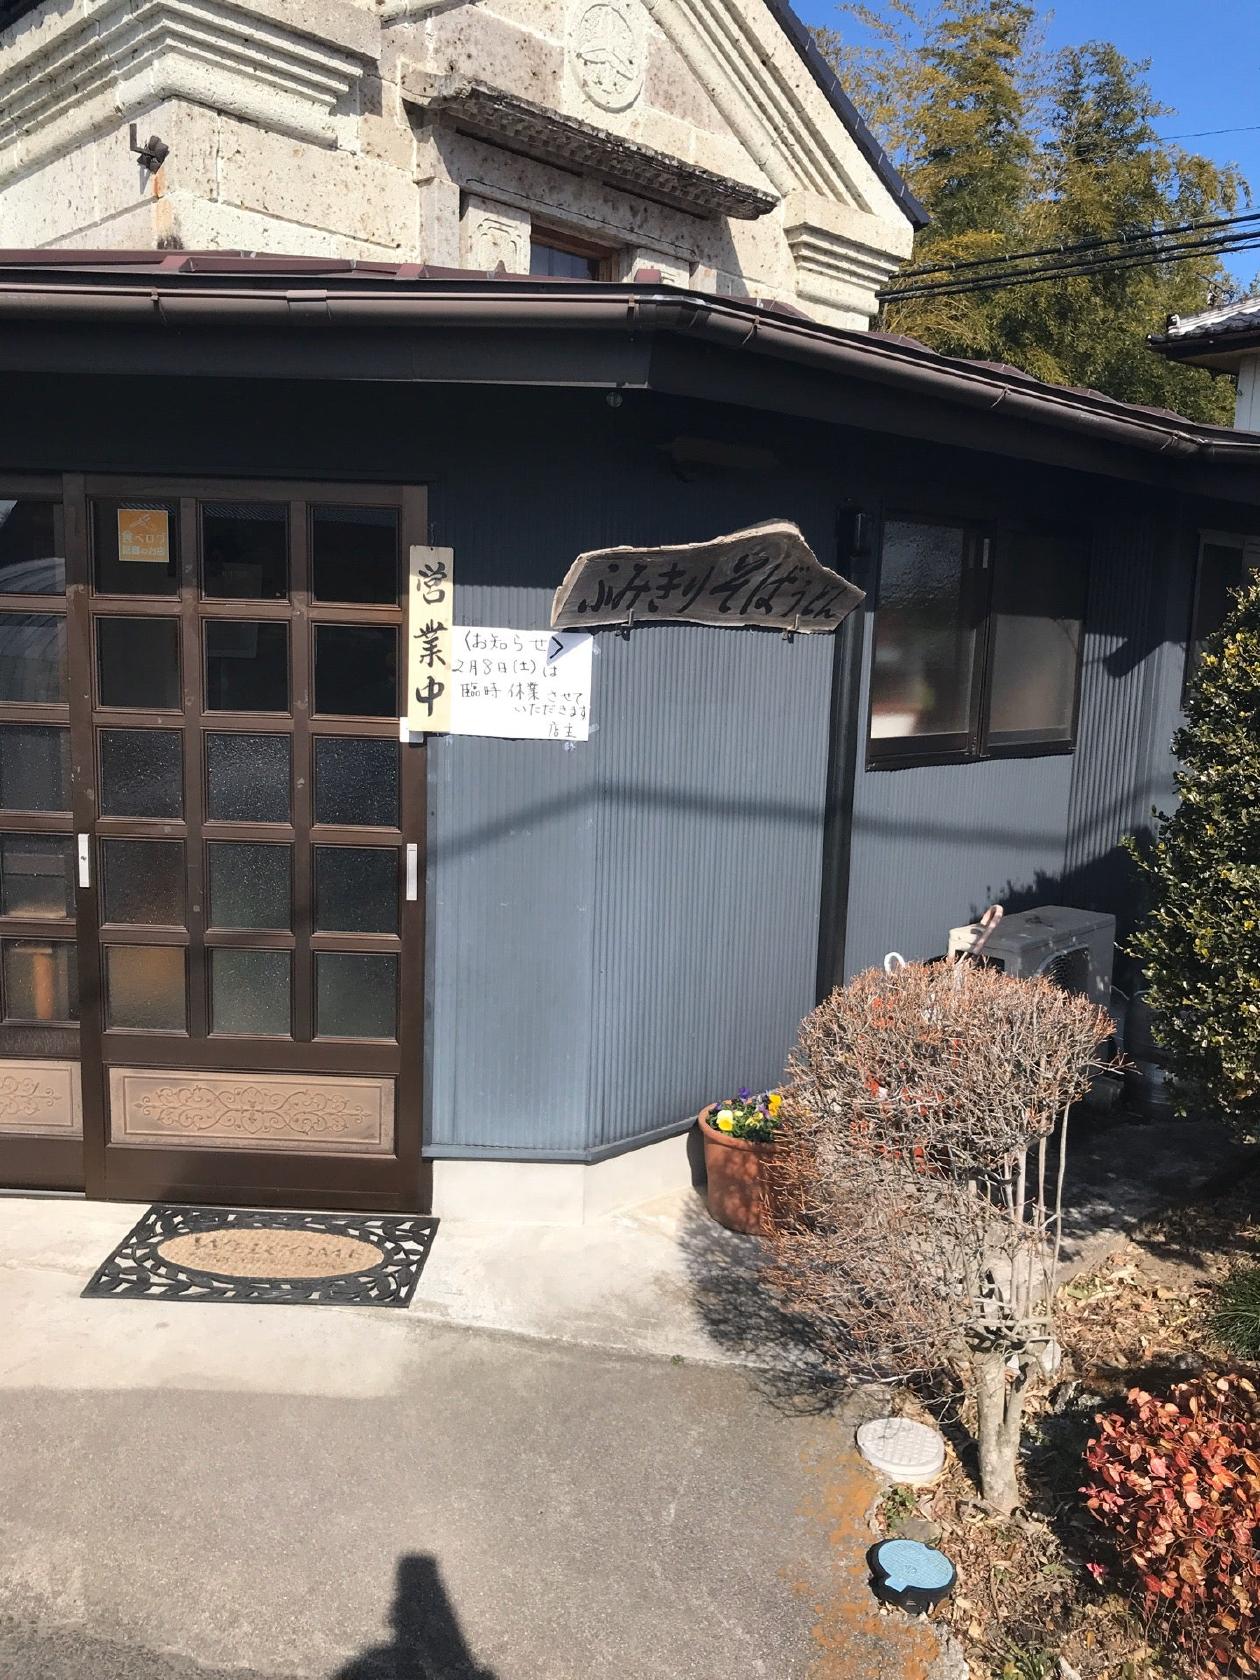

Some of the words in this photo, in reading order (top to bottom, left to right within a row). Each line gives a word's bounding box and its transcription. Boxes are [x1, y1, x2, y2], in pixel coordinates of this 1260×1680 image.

[413, 561, 448, 717] 営業中
[514, 703, 586, 721] いただきます
[549, 722, 577, 738] 店主
